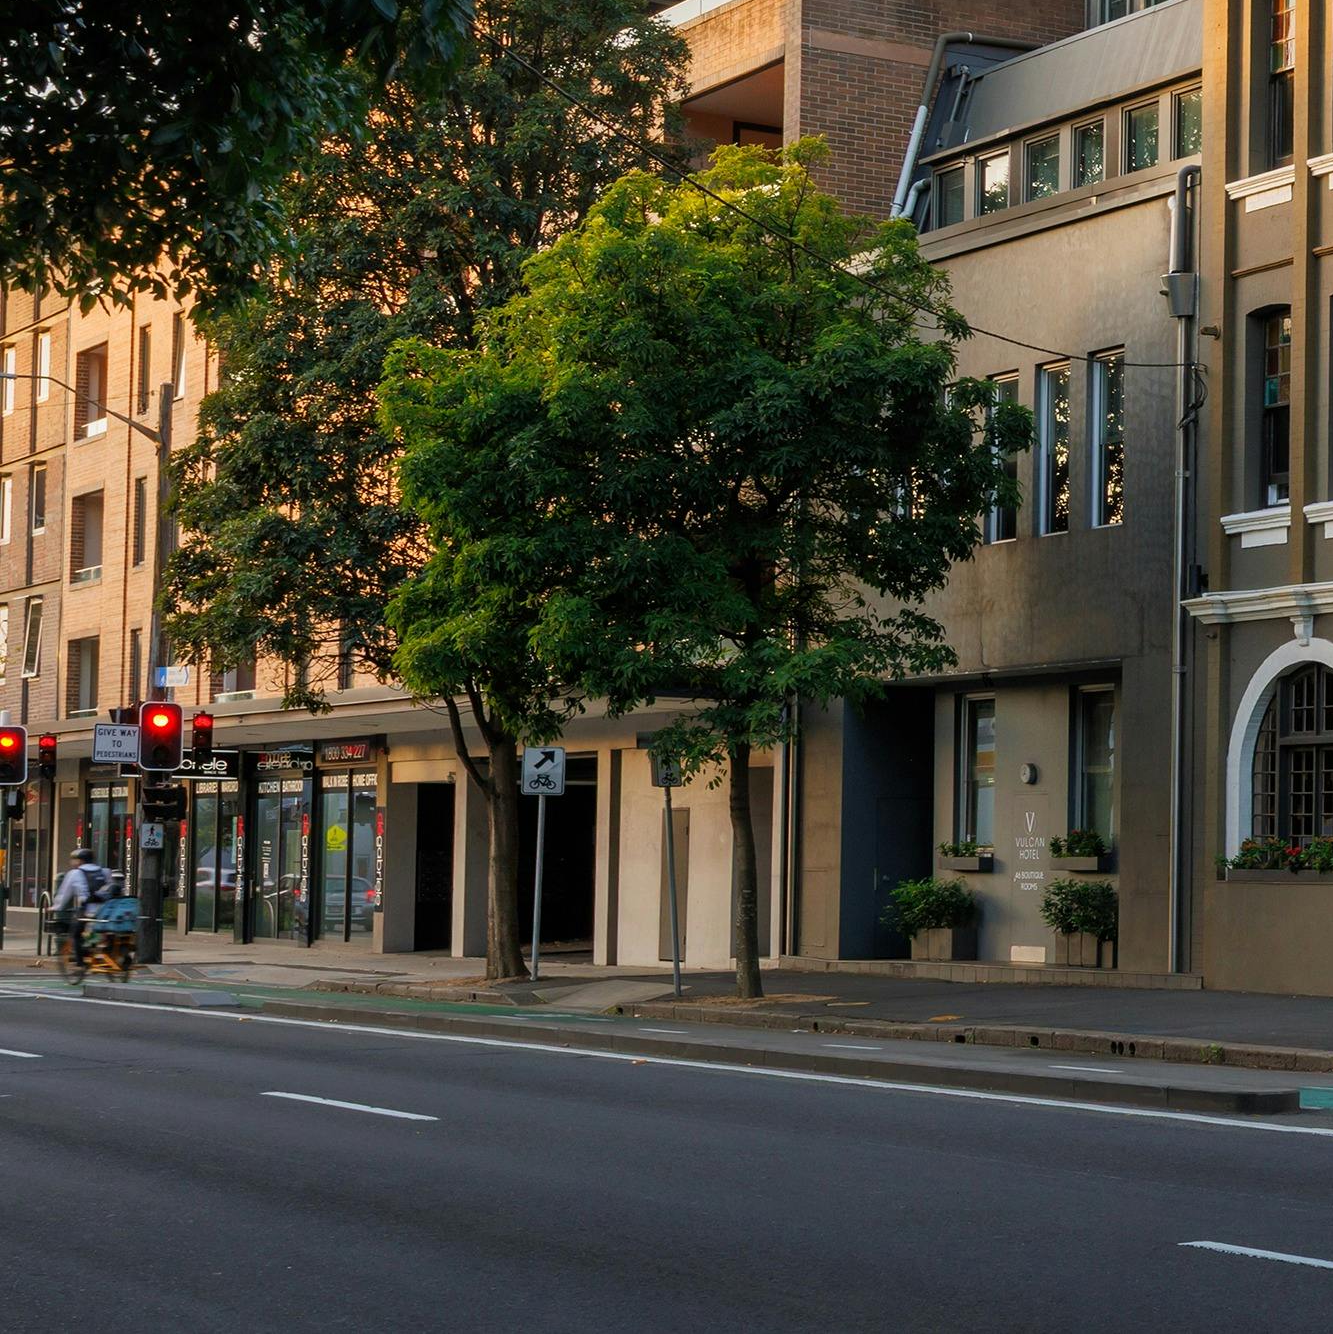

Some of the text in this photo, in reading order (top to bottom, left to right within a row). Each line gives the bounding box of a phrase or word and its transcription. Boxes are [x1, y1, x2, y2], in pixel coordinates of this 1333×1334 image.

[98, 728, 137, 737] GIVE WAY
[112, 740, 122, 748] TO
[96, 750, 136, 759] PEDESTRIANS
[1015, 837, 1045, 847] VULCAN
[1019, 849, 1040, 860] HOTEL
[1021, 871, 1044, 880] BOUTIQUE
[1020, 882, 1038, 891] ROOMS
